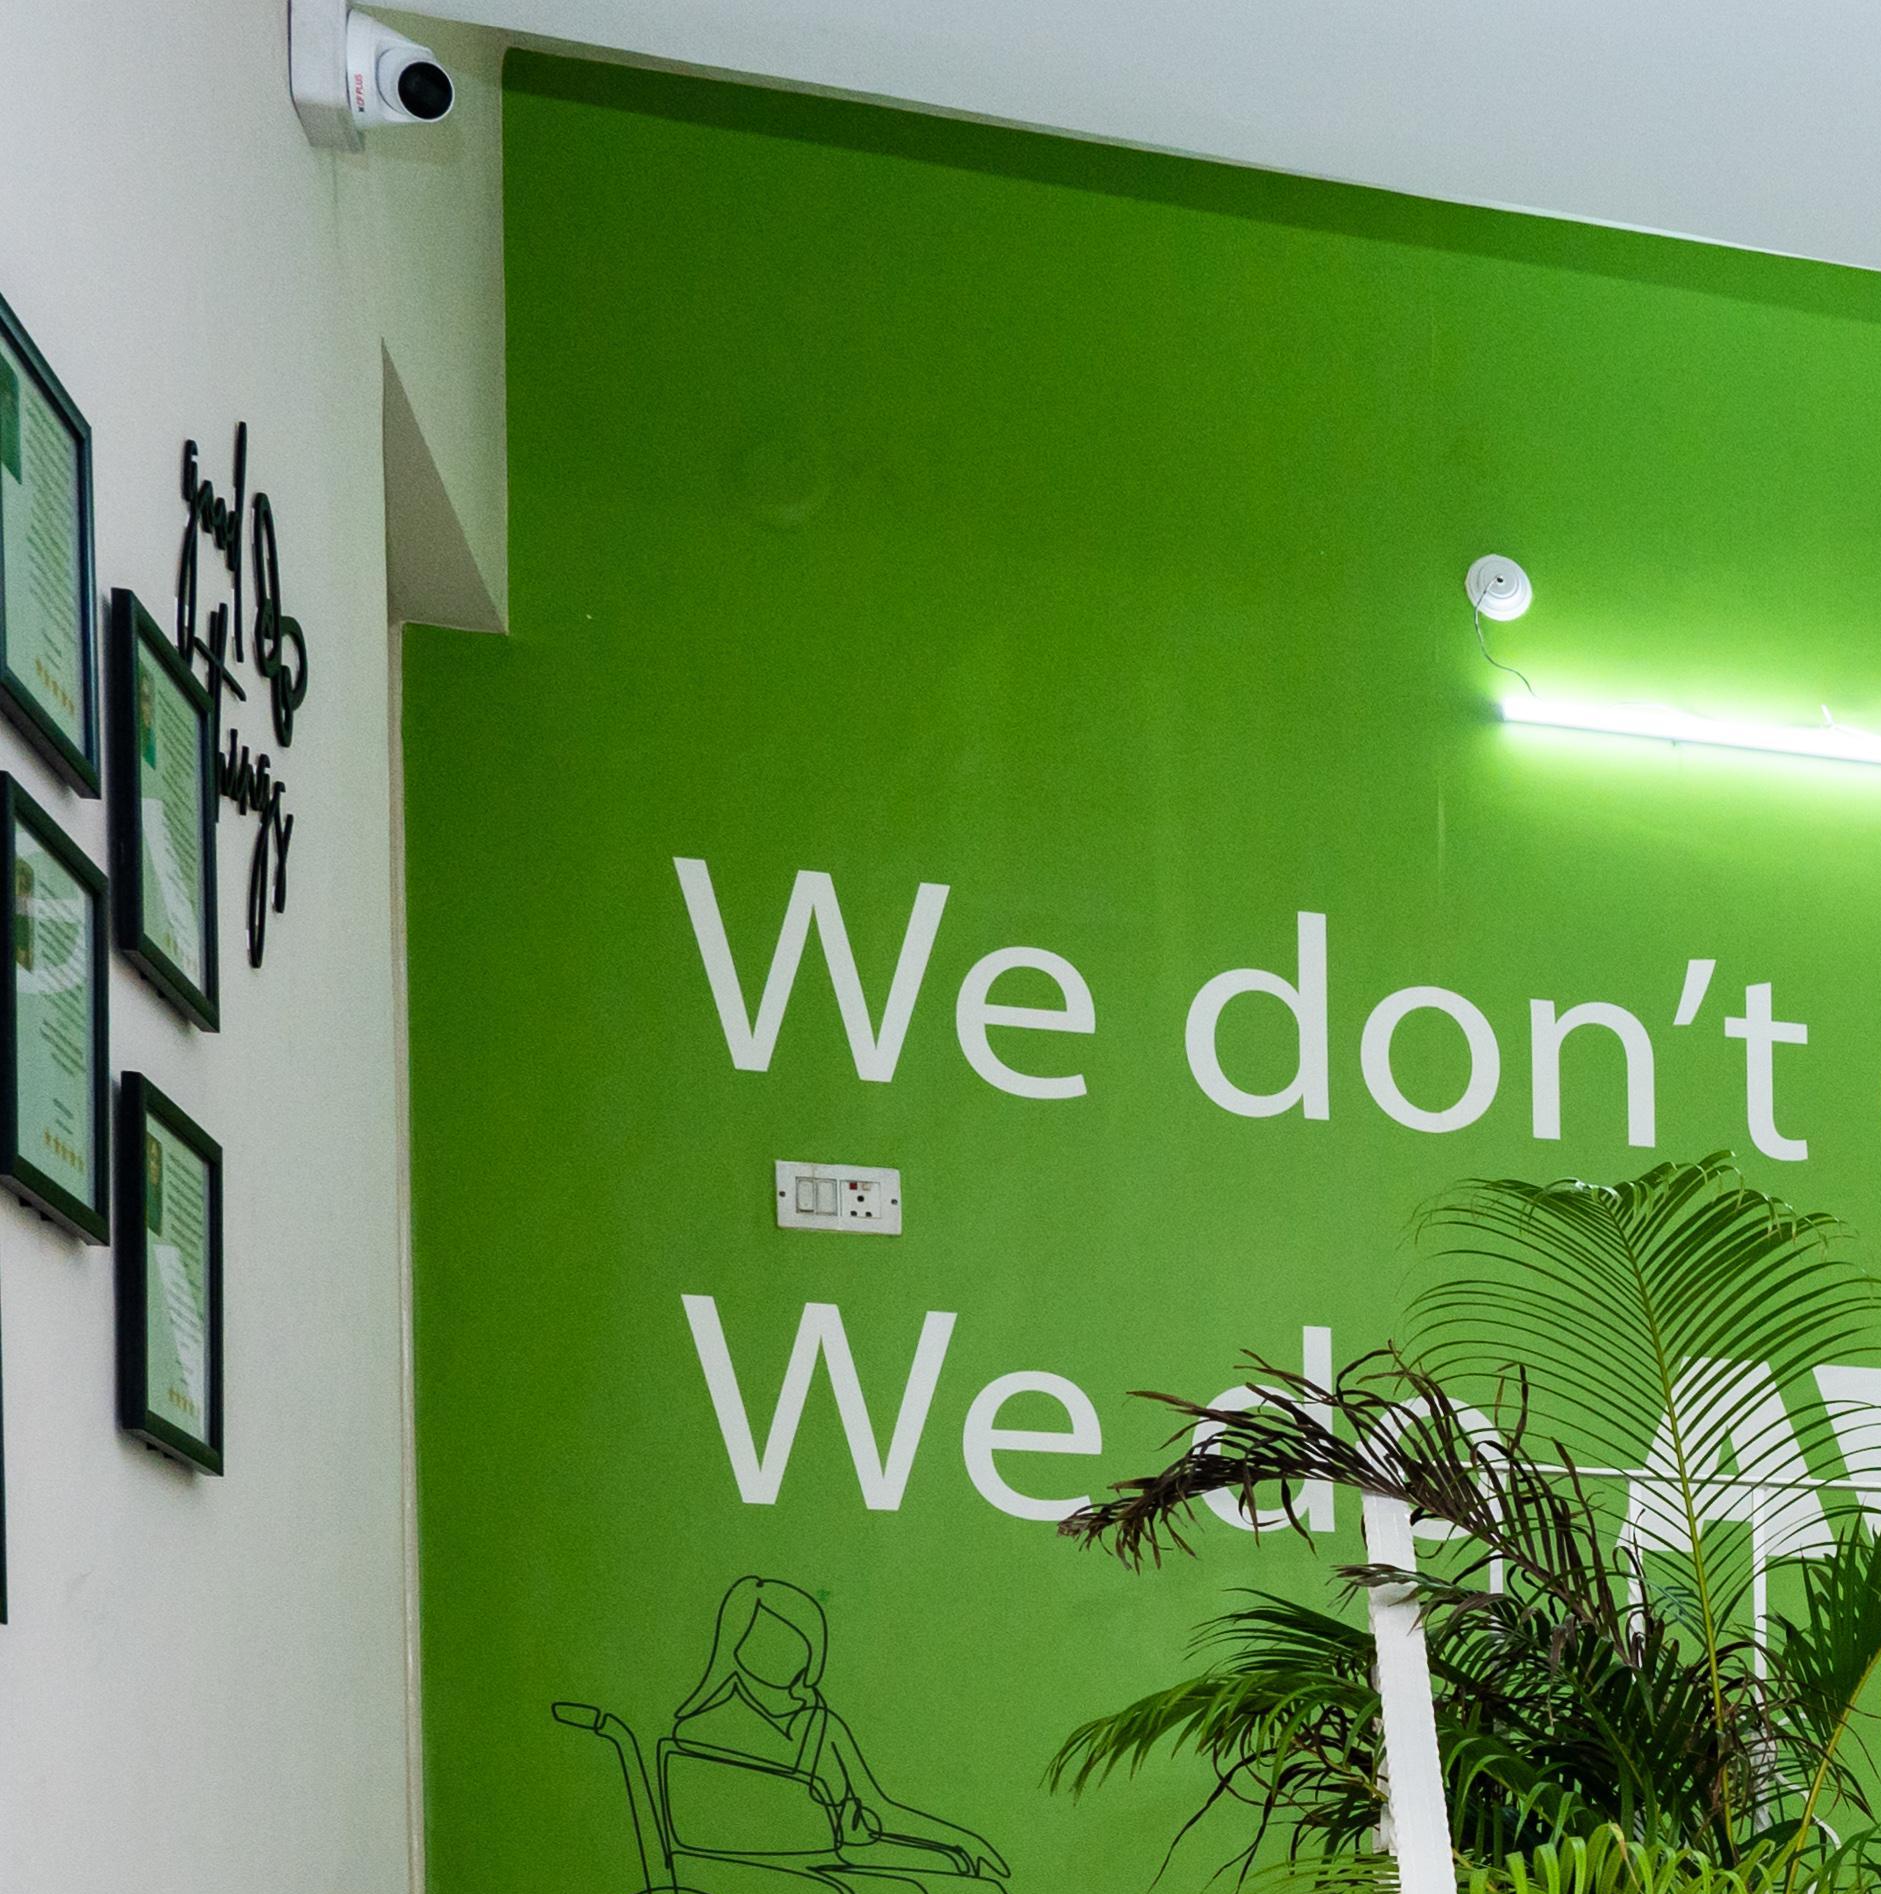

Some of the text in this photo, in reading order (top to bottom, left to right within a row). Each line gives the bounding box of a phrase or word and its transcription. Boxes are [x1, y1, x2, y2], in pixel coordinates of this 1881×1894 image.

[672, 855, 1097, 1099] We
[1184, 910, 1810, 1162] don't
[680, 1293, 1104, 1523] We
